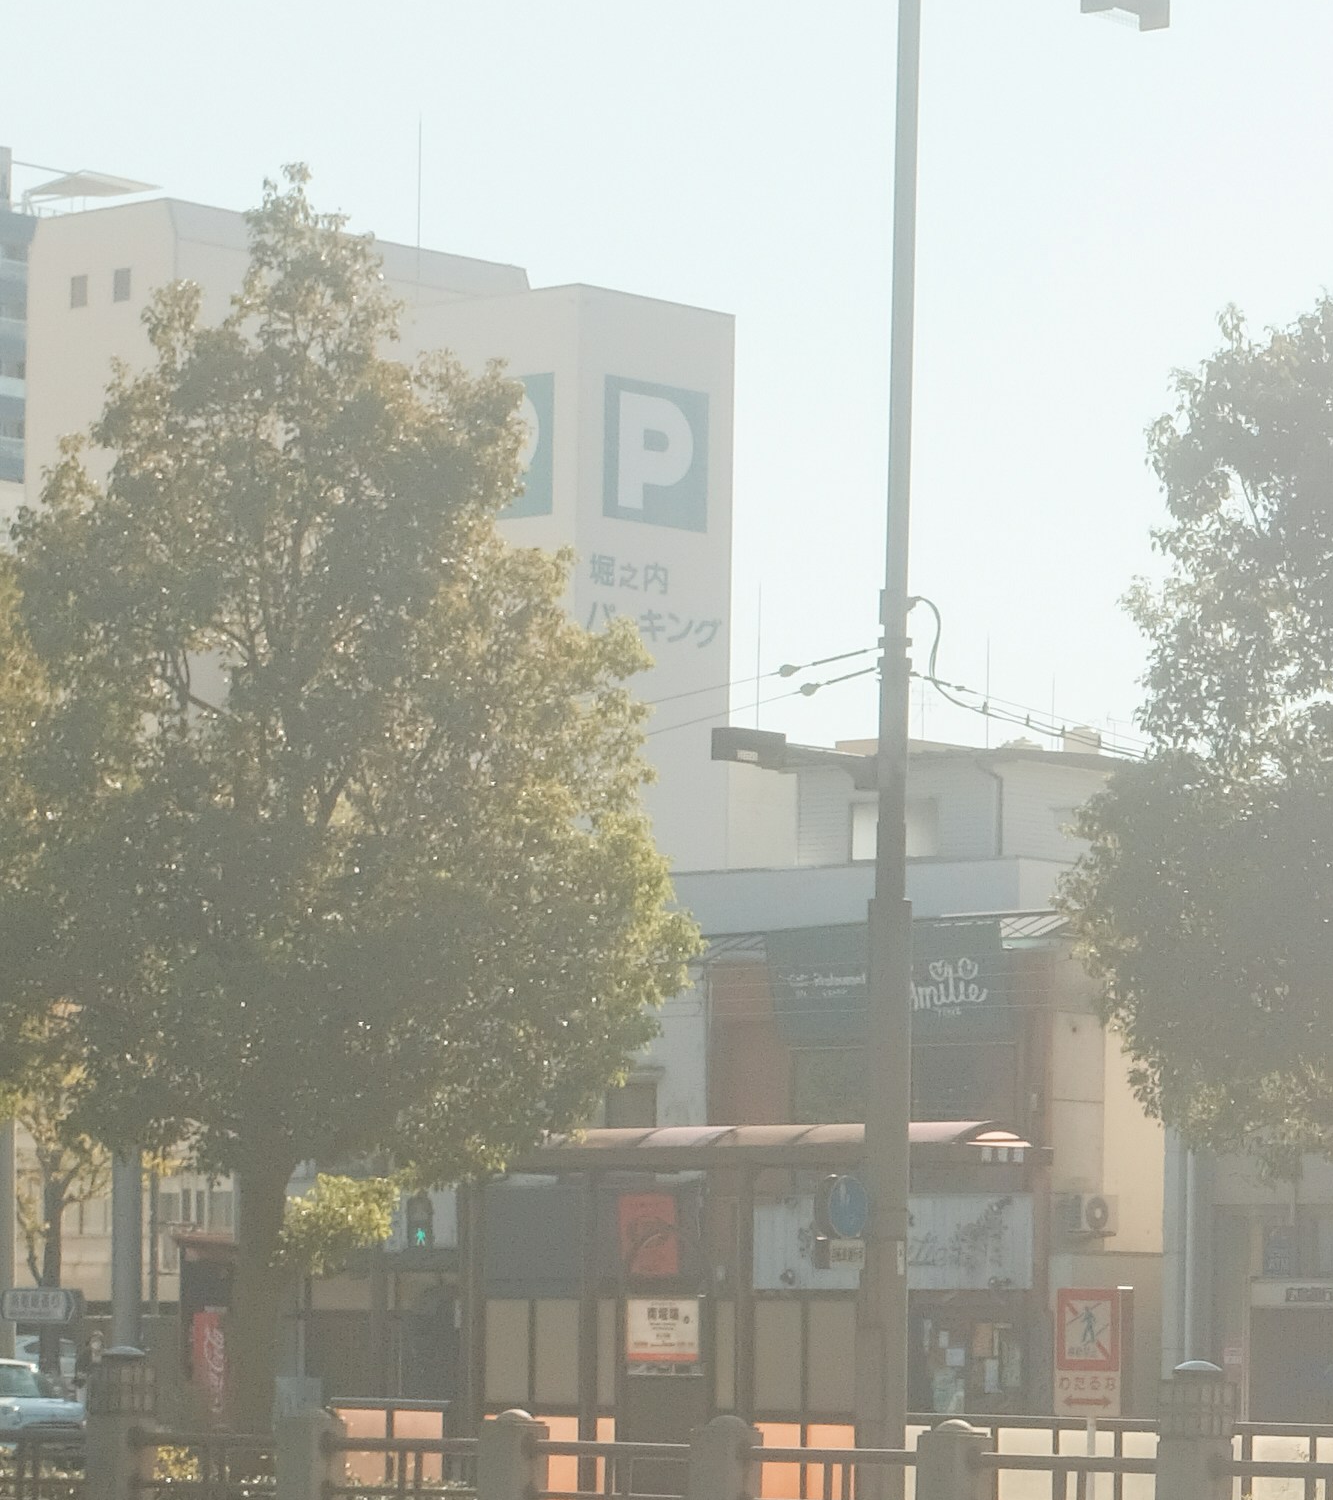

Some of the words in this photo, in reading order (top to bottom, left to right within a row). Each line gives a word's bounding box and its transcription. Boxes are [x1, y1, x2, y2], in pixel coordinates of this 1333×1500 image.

[617, 390, 694, 510] P
[589, 553, 669, 595] 堀之内
[586, 601, 722, 649] パキング
